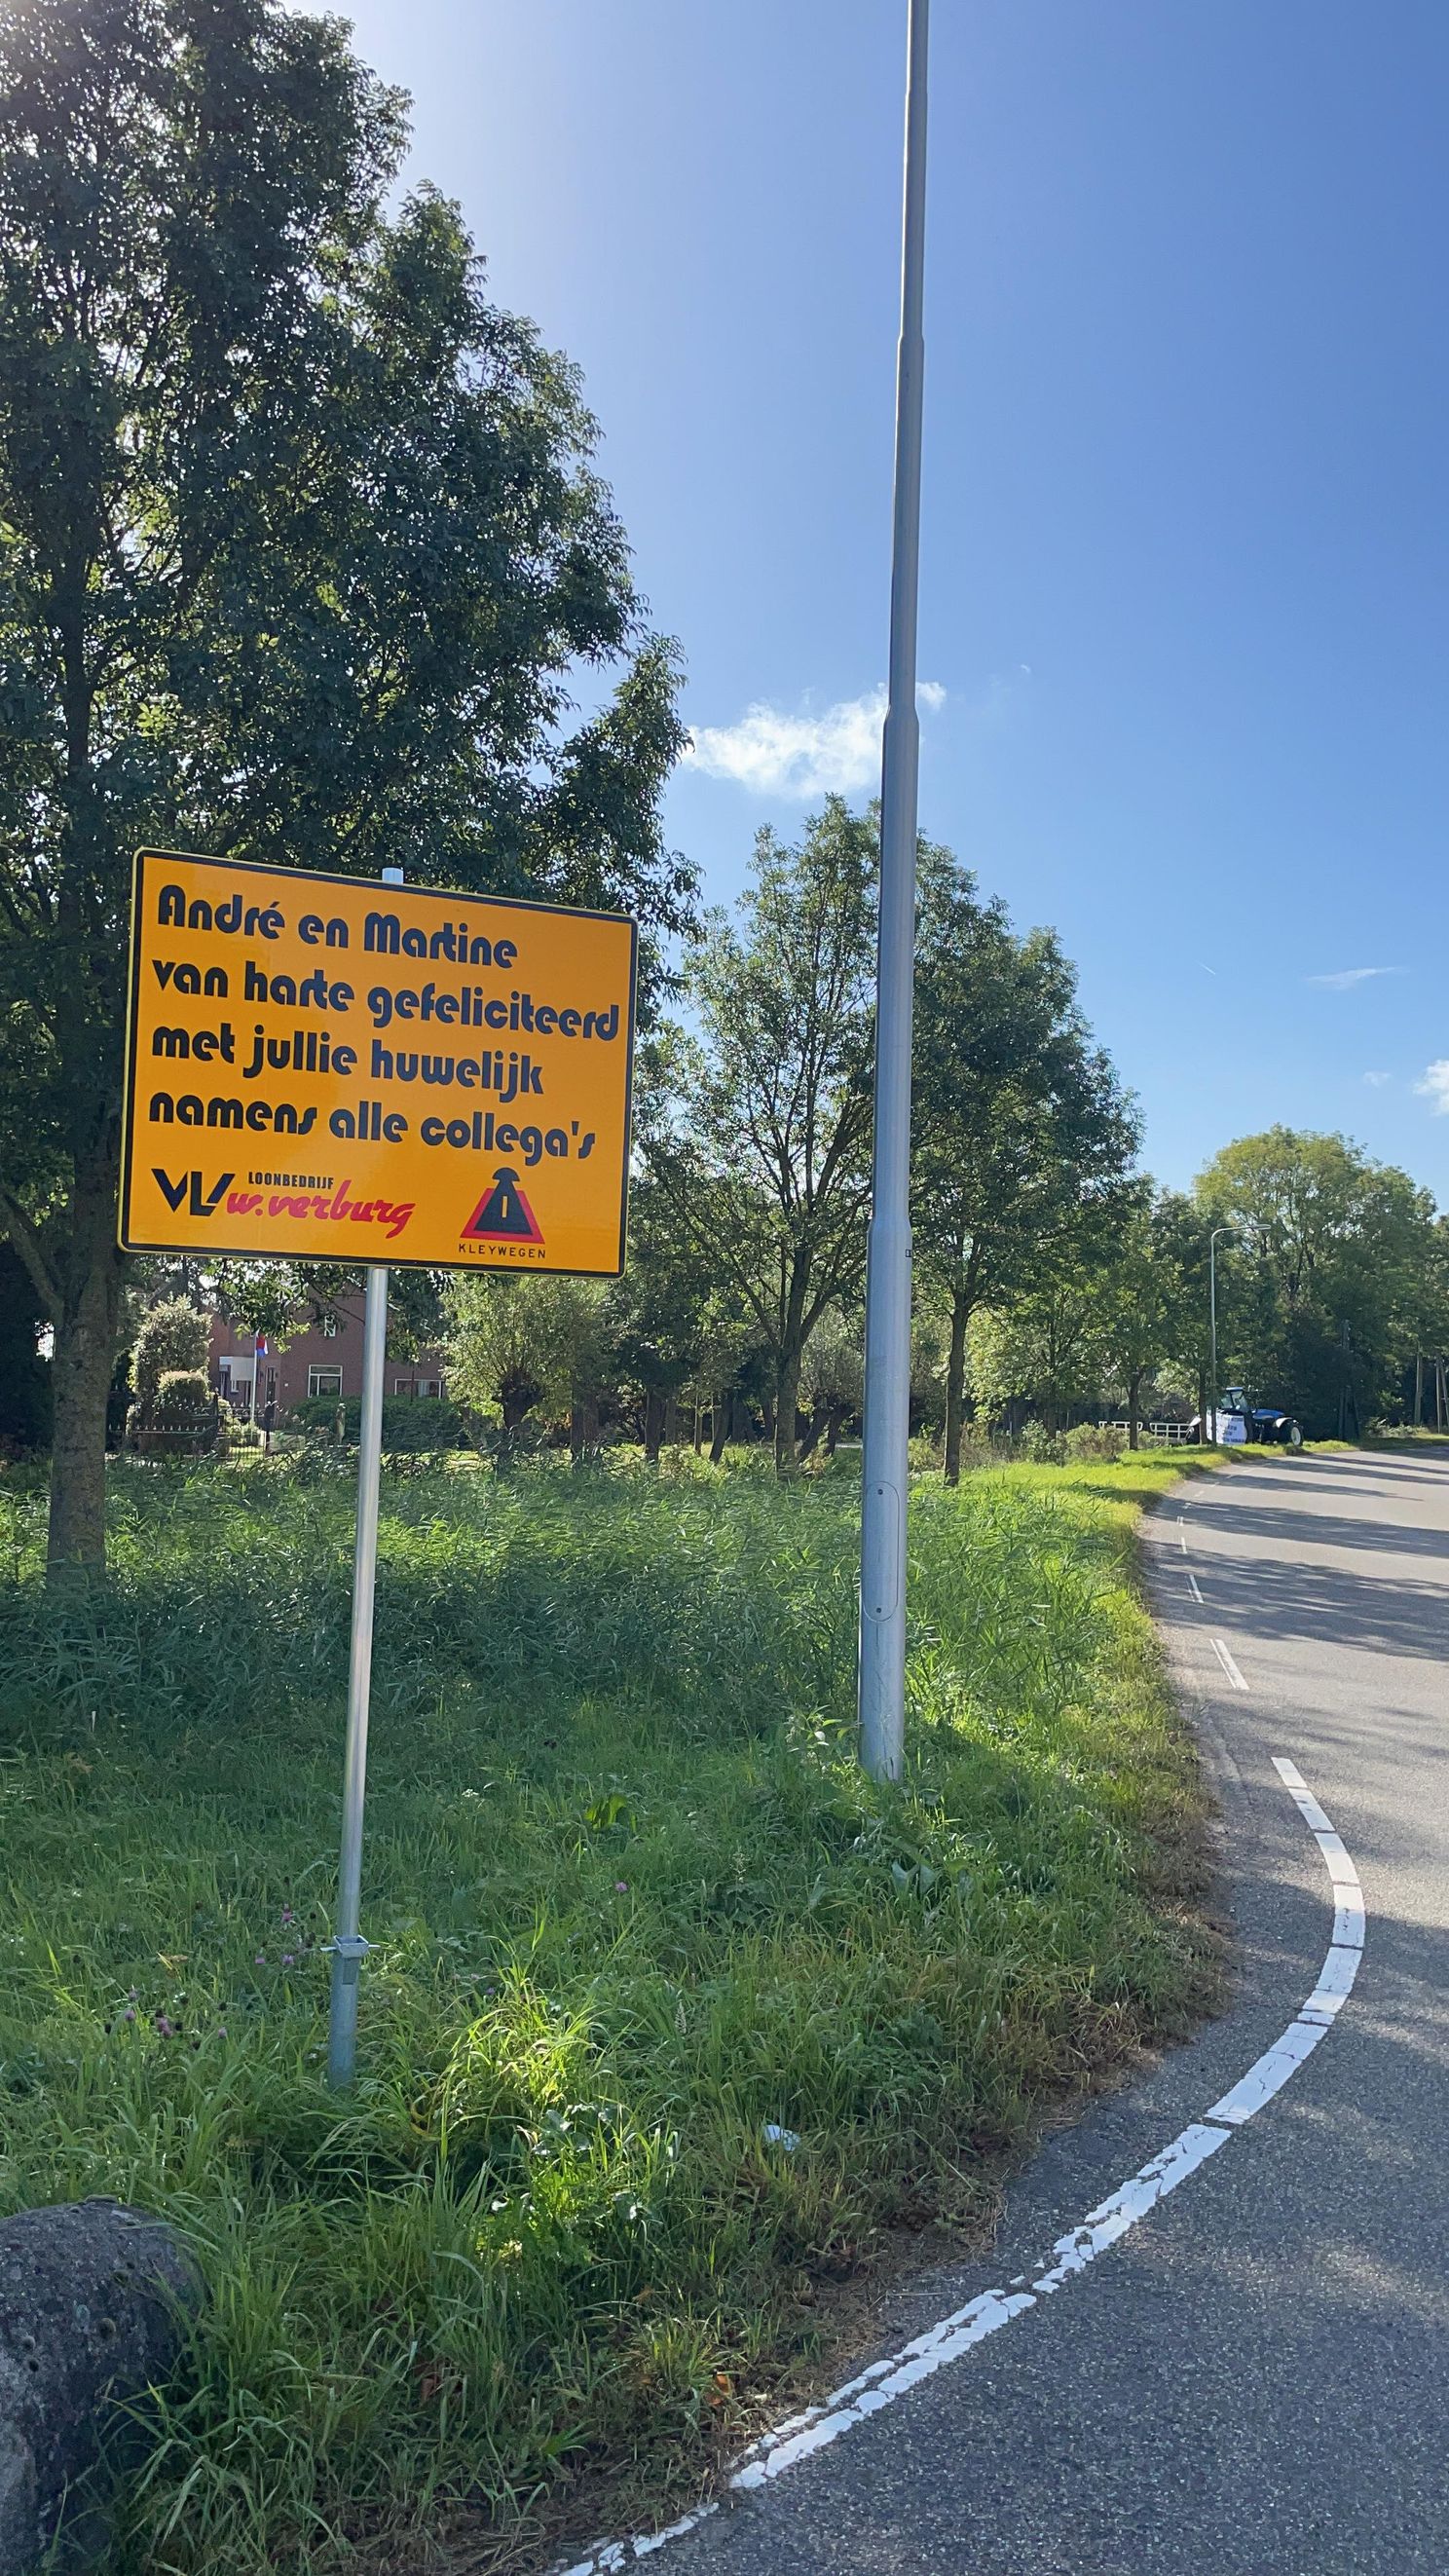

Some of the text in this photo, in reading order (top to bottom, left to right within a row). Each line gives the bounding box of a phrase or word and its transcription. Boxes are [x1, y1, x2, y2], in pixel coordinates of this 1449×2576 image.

[158, 884, 519, 969] André en Martine
[151, 959, 619, 1042] van harte gefeliciteerd
[152, 1022, 545, 1103] met jullie huwelijk
[149, 1091, 596, 1167] namens alle collega's
[247, 1171, 334, 1190] LOONBEDRIJF
[458, 1243, 546, 1259] KLEYWEGEN
